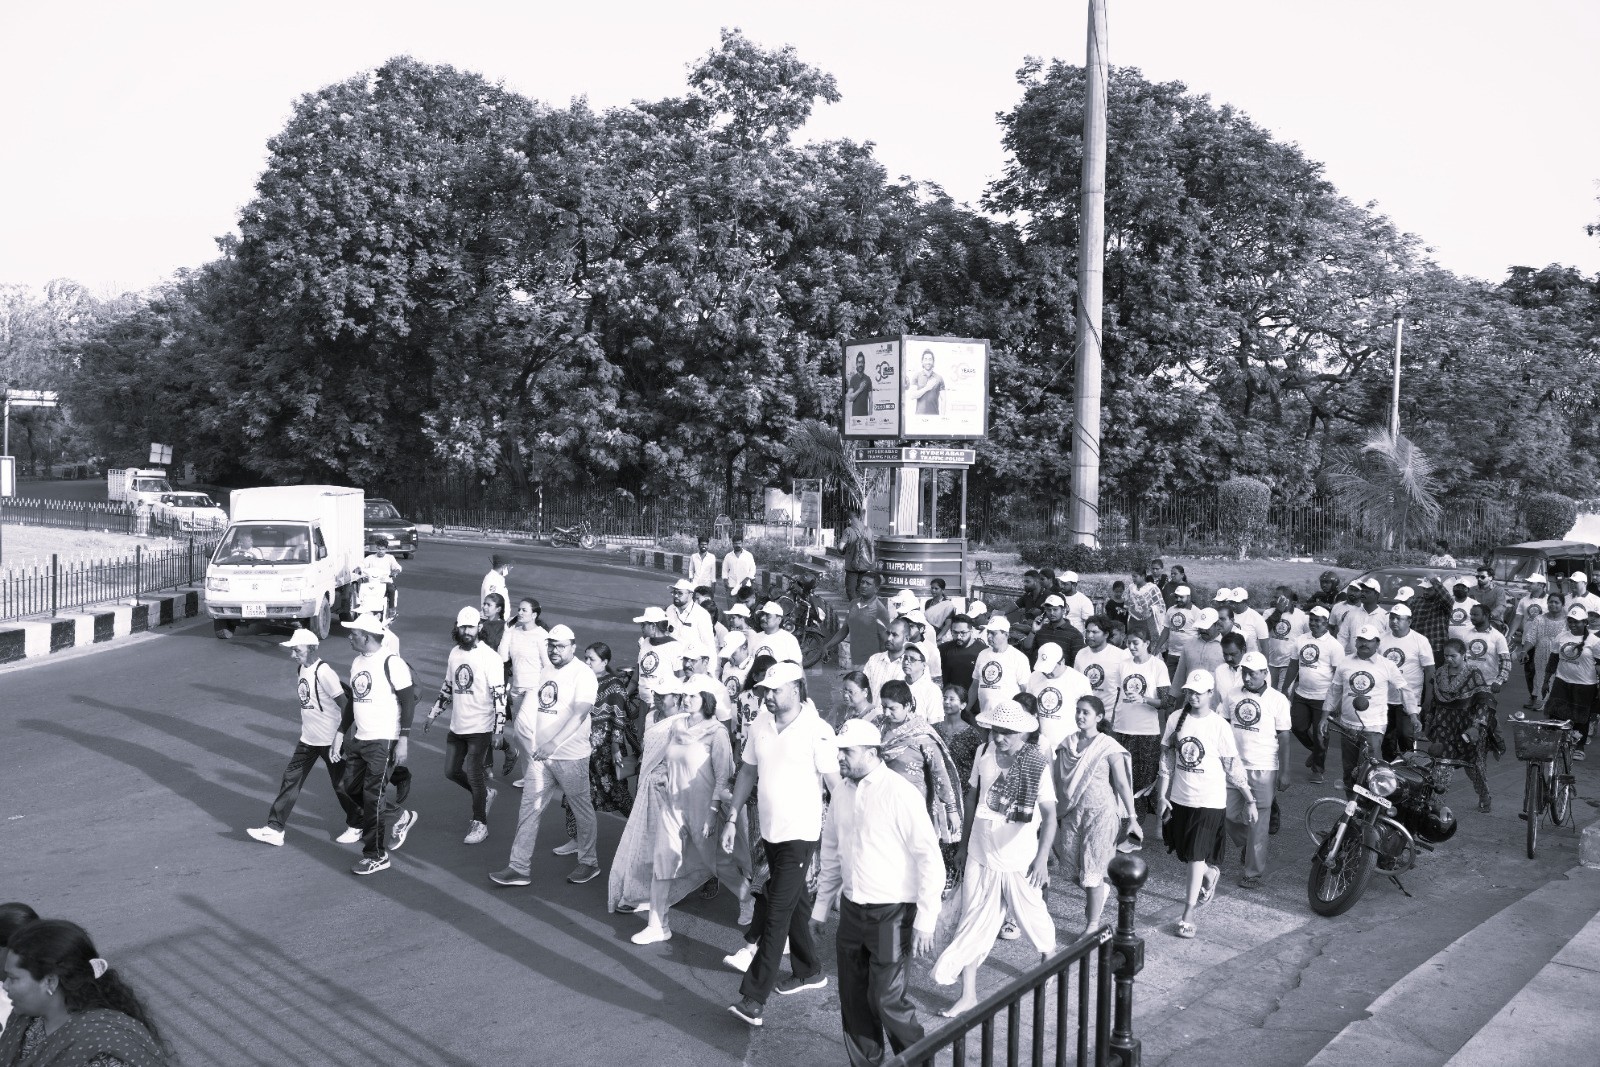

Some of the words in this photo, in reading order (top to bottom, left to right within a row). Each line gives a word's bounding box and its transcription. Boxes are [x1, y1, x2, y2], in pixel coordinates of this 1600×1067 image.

[886, 562, 905, 571] TRAFFIC
[905, 562, 923, 571] POLICE
[888, 577, 903, 585] CLEAN
[909, 578, 926, 586] GREEN
